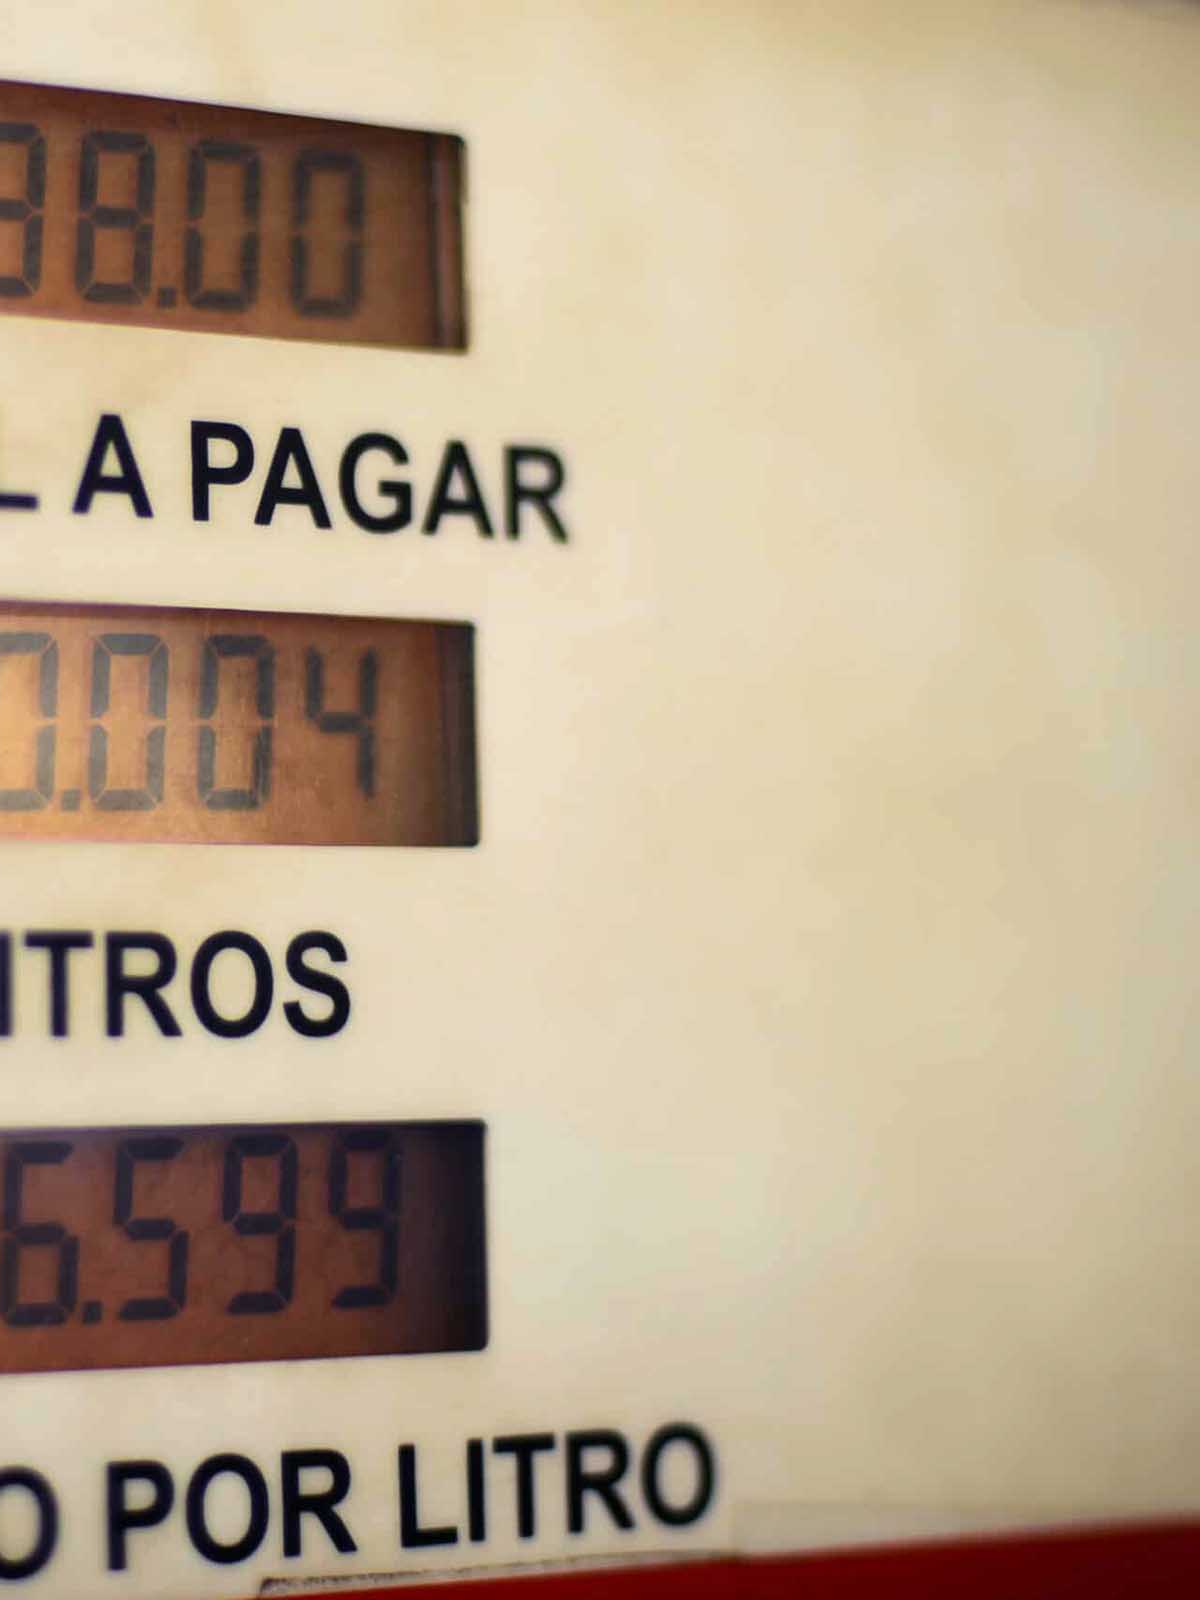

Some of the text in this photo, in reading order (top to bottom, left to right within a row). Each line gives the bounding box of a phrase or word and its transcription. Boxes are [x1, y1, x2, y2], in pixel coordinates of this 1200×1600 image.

[73, 413, 153, 518] A
[190, 419, 569, 543] PAGAR
[106, 1449, 355, 1572] POR
[400, 1421, 714, 1551] LITRO
